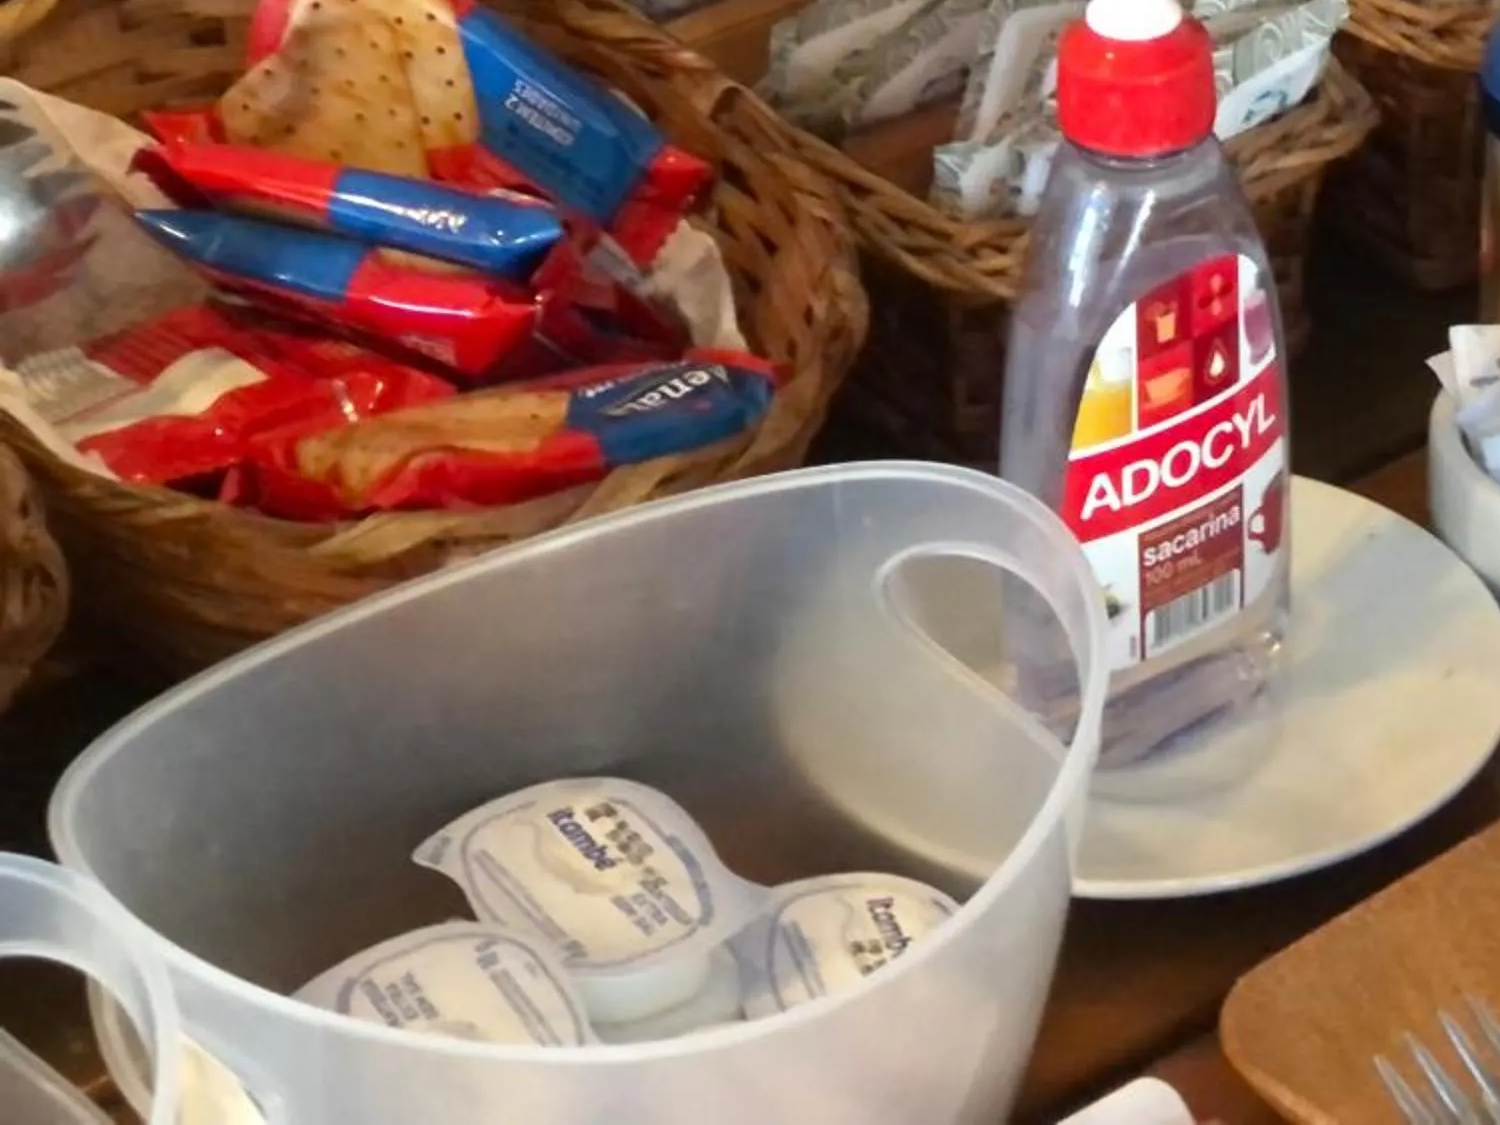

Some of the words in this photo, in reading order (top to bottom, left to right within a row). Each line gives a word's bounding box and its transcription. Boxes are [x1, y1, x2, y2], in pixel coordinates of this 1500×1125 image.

[1081, 393, 1276, 521] ADOCYL
[1143, 505, 1240, 567] sacarina
[546, 807, 625, 871] Itambé
